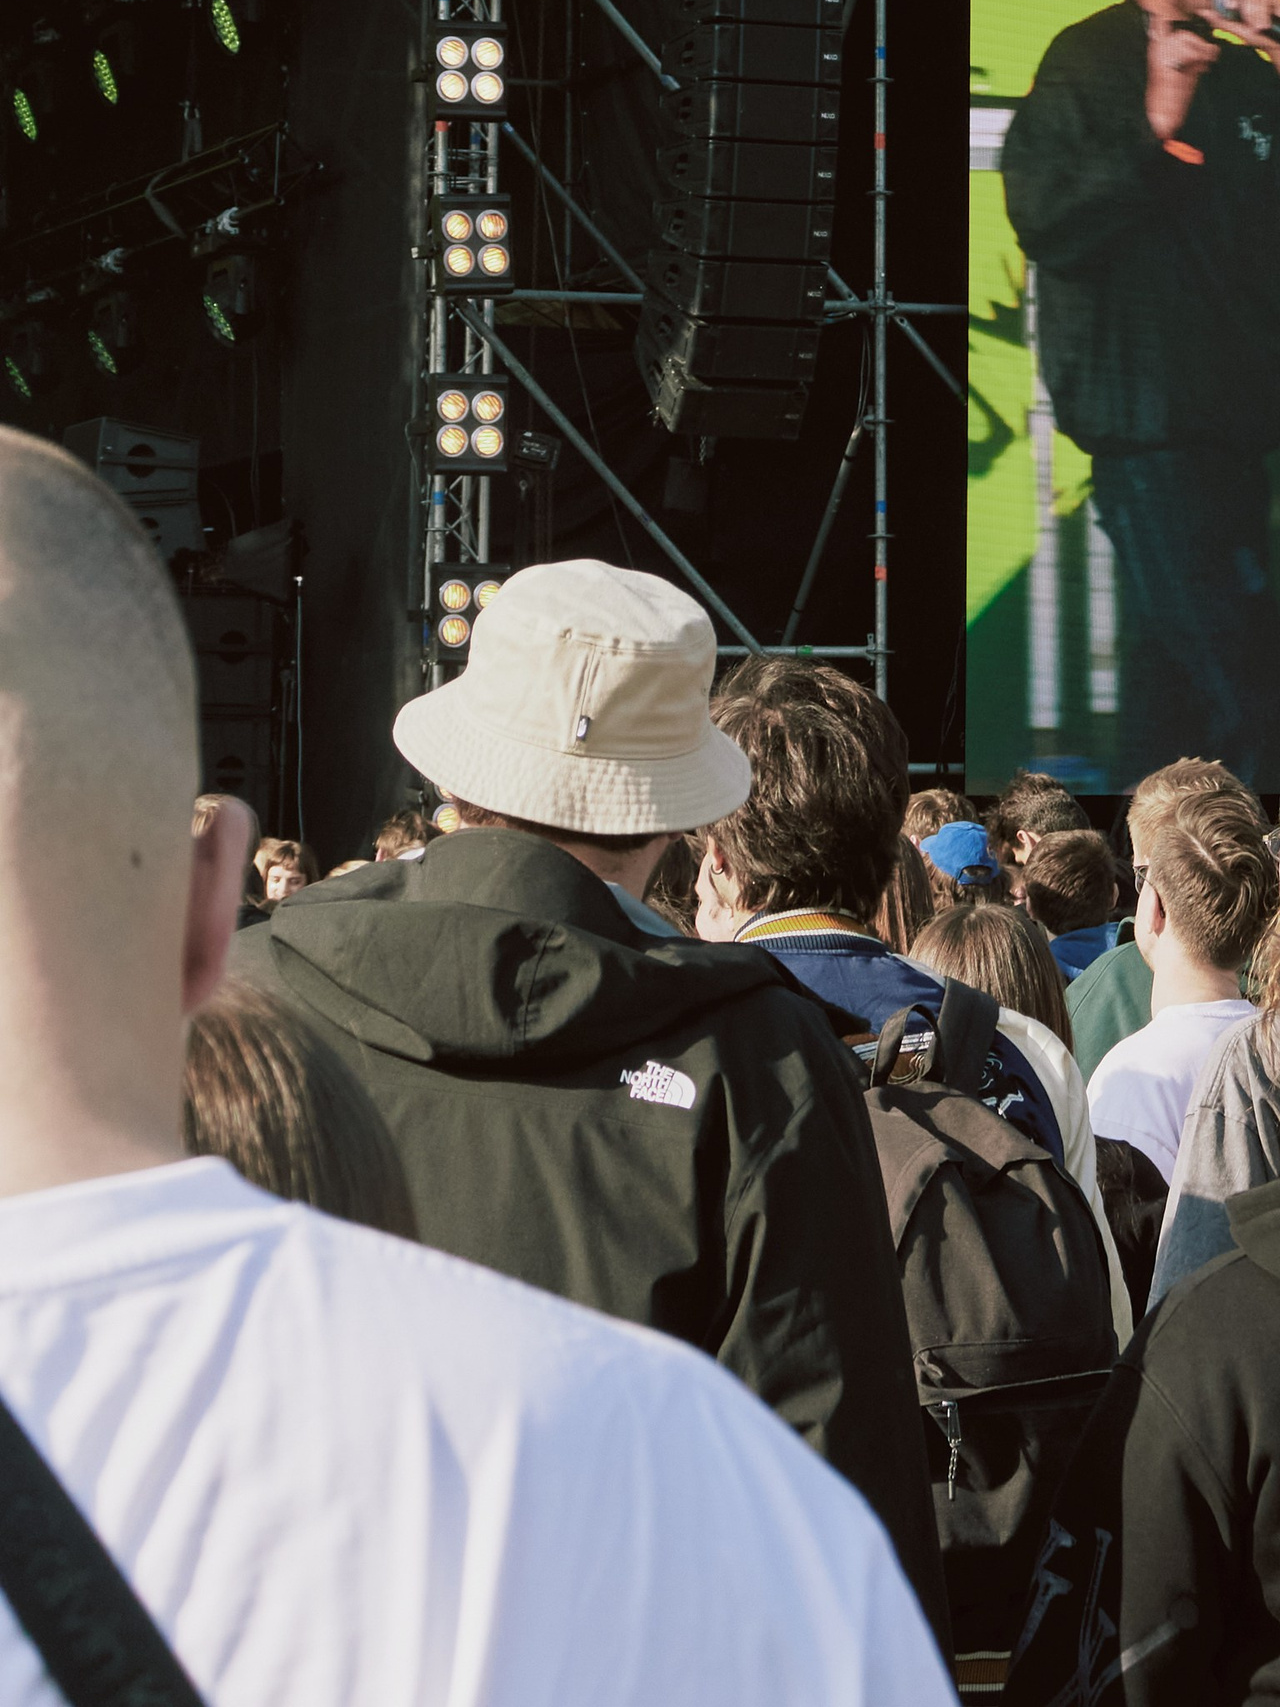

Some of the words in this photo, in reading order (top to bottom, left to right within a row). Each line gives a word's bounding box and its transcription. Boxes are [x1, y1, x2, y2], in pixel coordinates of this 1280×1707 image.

[646, 1060, 676, 1078] THE
[619, 1068, 673, 1091] NORTH
[629, 1085, 666, 1102] FACE
